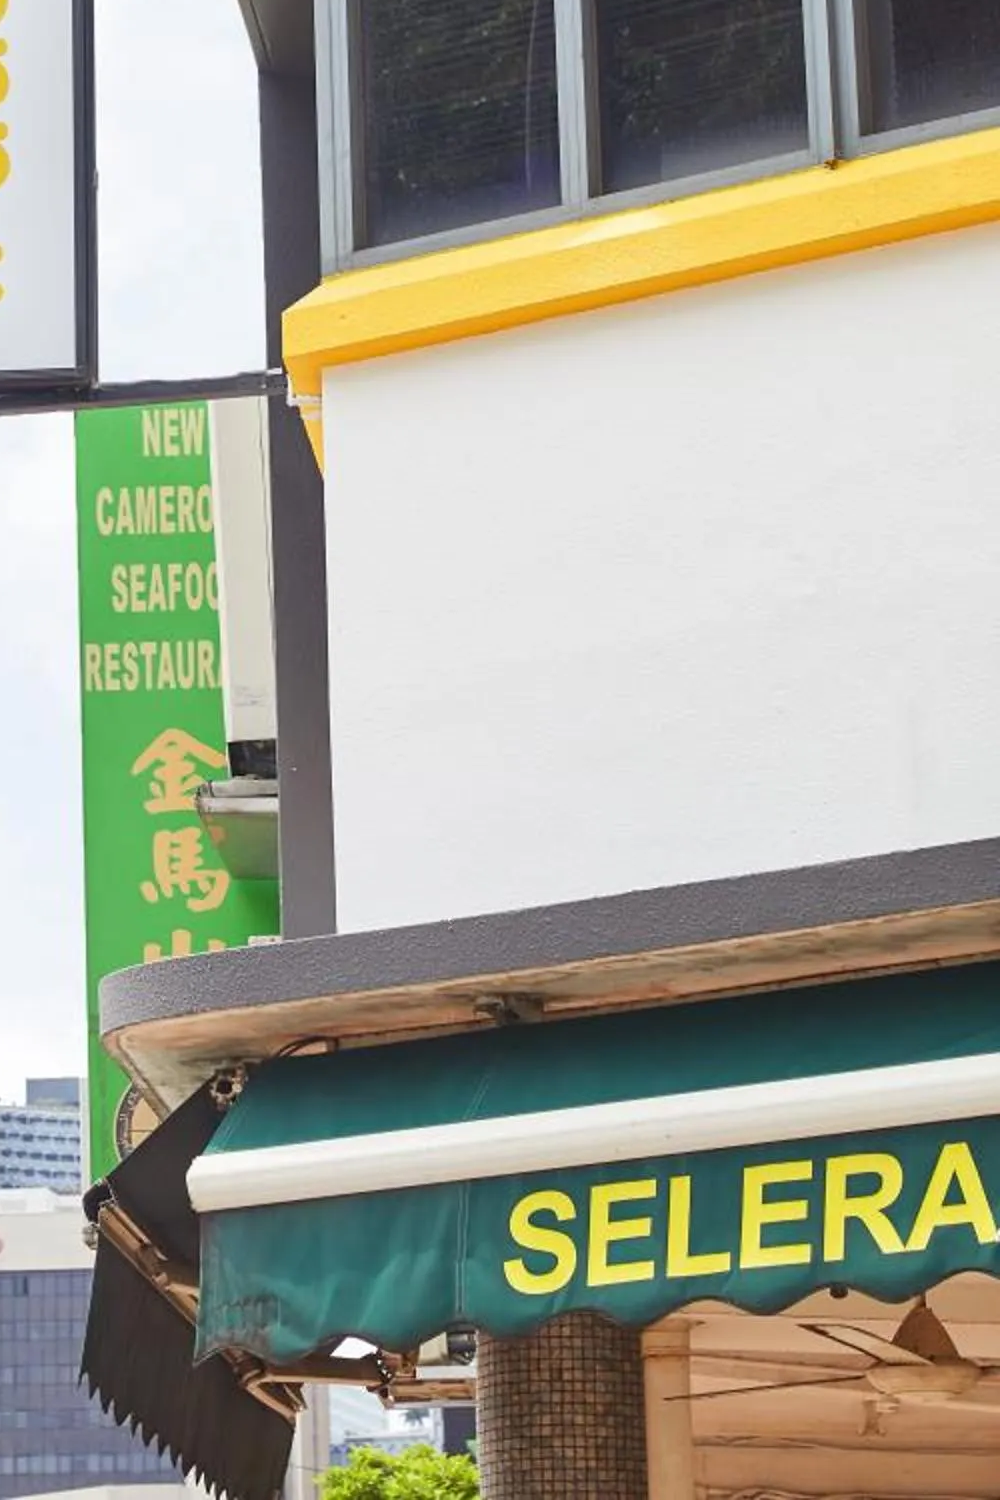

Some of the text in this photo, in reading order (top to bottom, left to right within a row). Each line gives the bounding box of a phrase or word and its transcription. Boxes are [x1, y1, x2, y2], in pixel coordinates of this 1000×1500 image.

[141, 409, 205, 457] NEW
[85, 640, 222, 692] RESTAUR
[503, 1141, 997, 1296] SELERA
